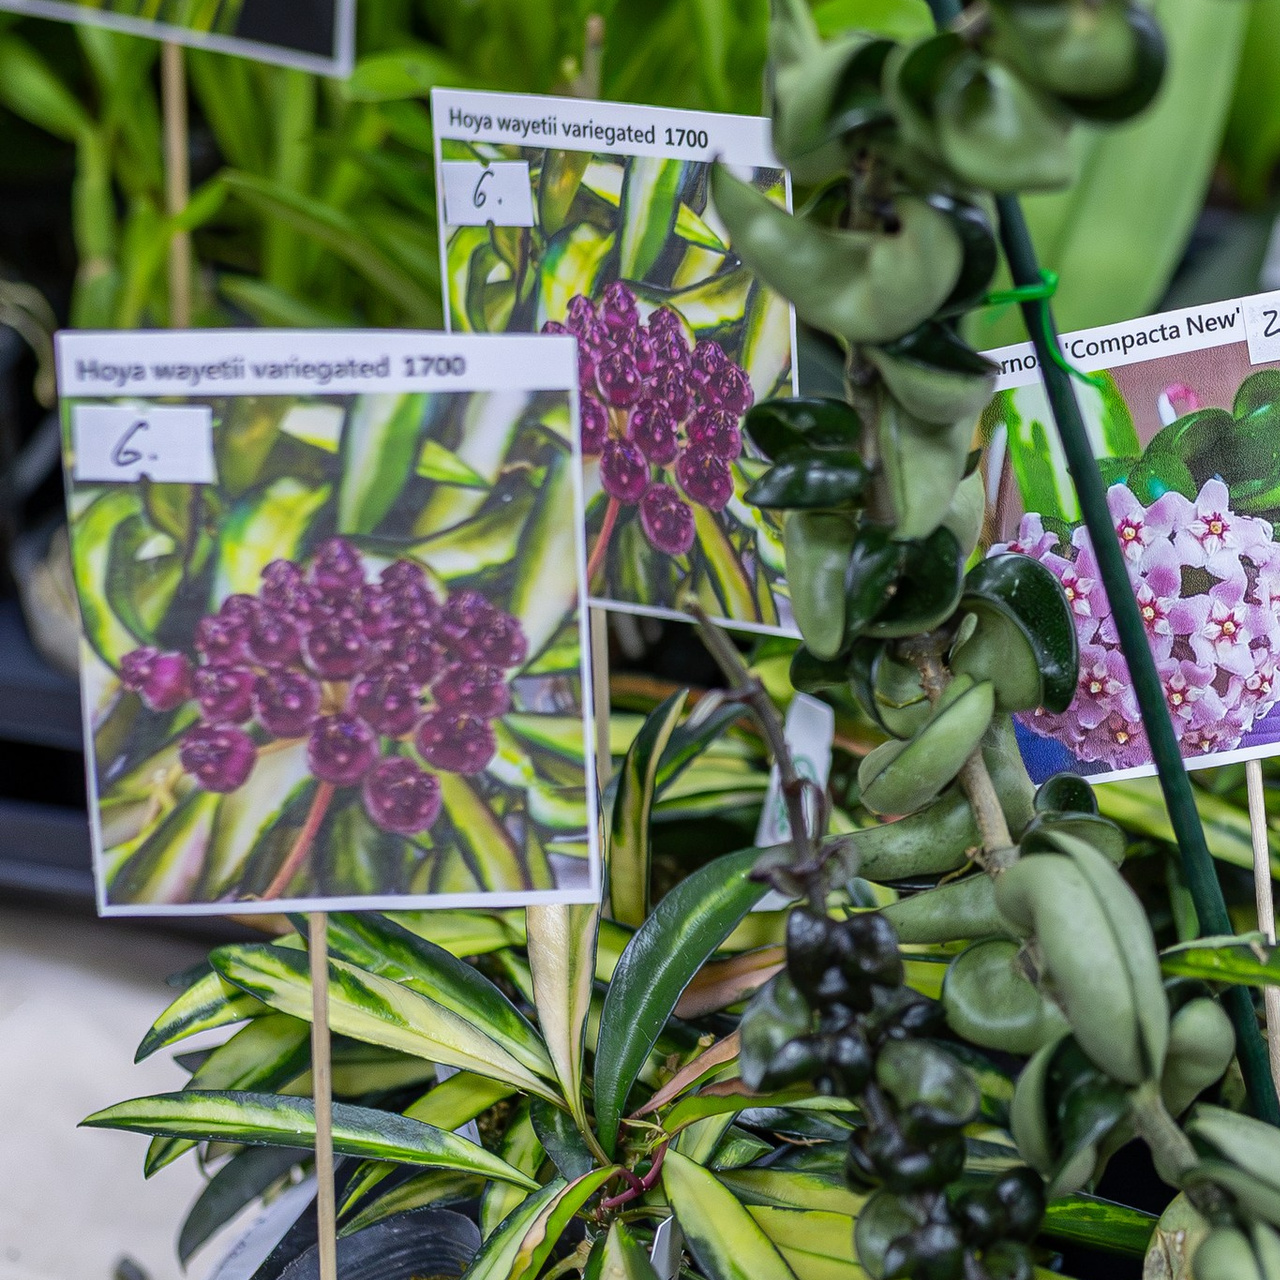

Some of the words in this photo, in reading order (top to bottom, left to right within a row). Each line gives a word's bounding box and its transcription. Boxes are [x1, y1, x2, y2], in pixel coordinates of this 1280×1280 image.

[449, 106, 493, 132] Hoya
[497, 116, 559, 139] wayetii
[562, 120, 656, 146] variegated
[664, 126, 709, 149] 1700
[1064, 325, 1182, 362] 'Compacta
[1186, 306, 1243, 337] New'
[75, 359, 145, 388] Hoya
[152, 356, 246, 386] wayetii
[250, 355, 391, 385] variegated
[403, 355, 467, 377] 1700
